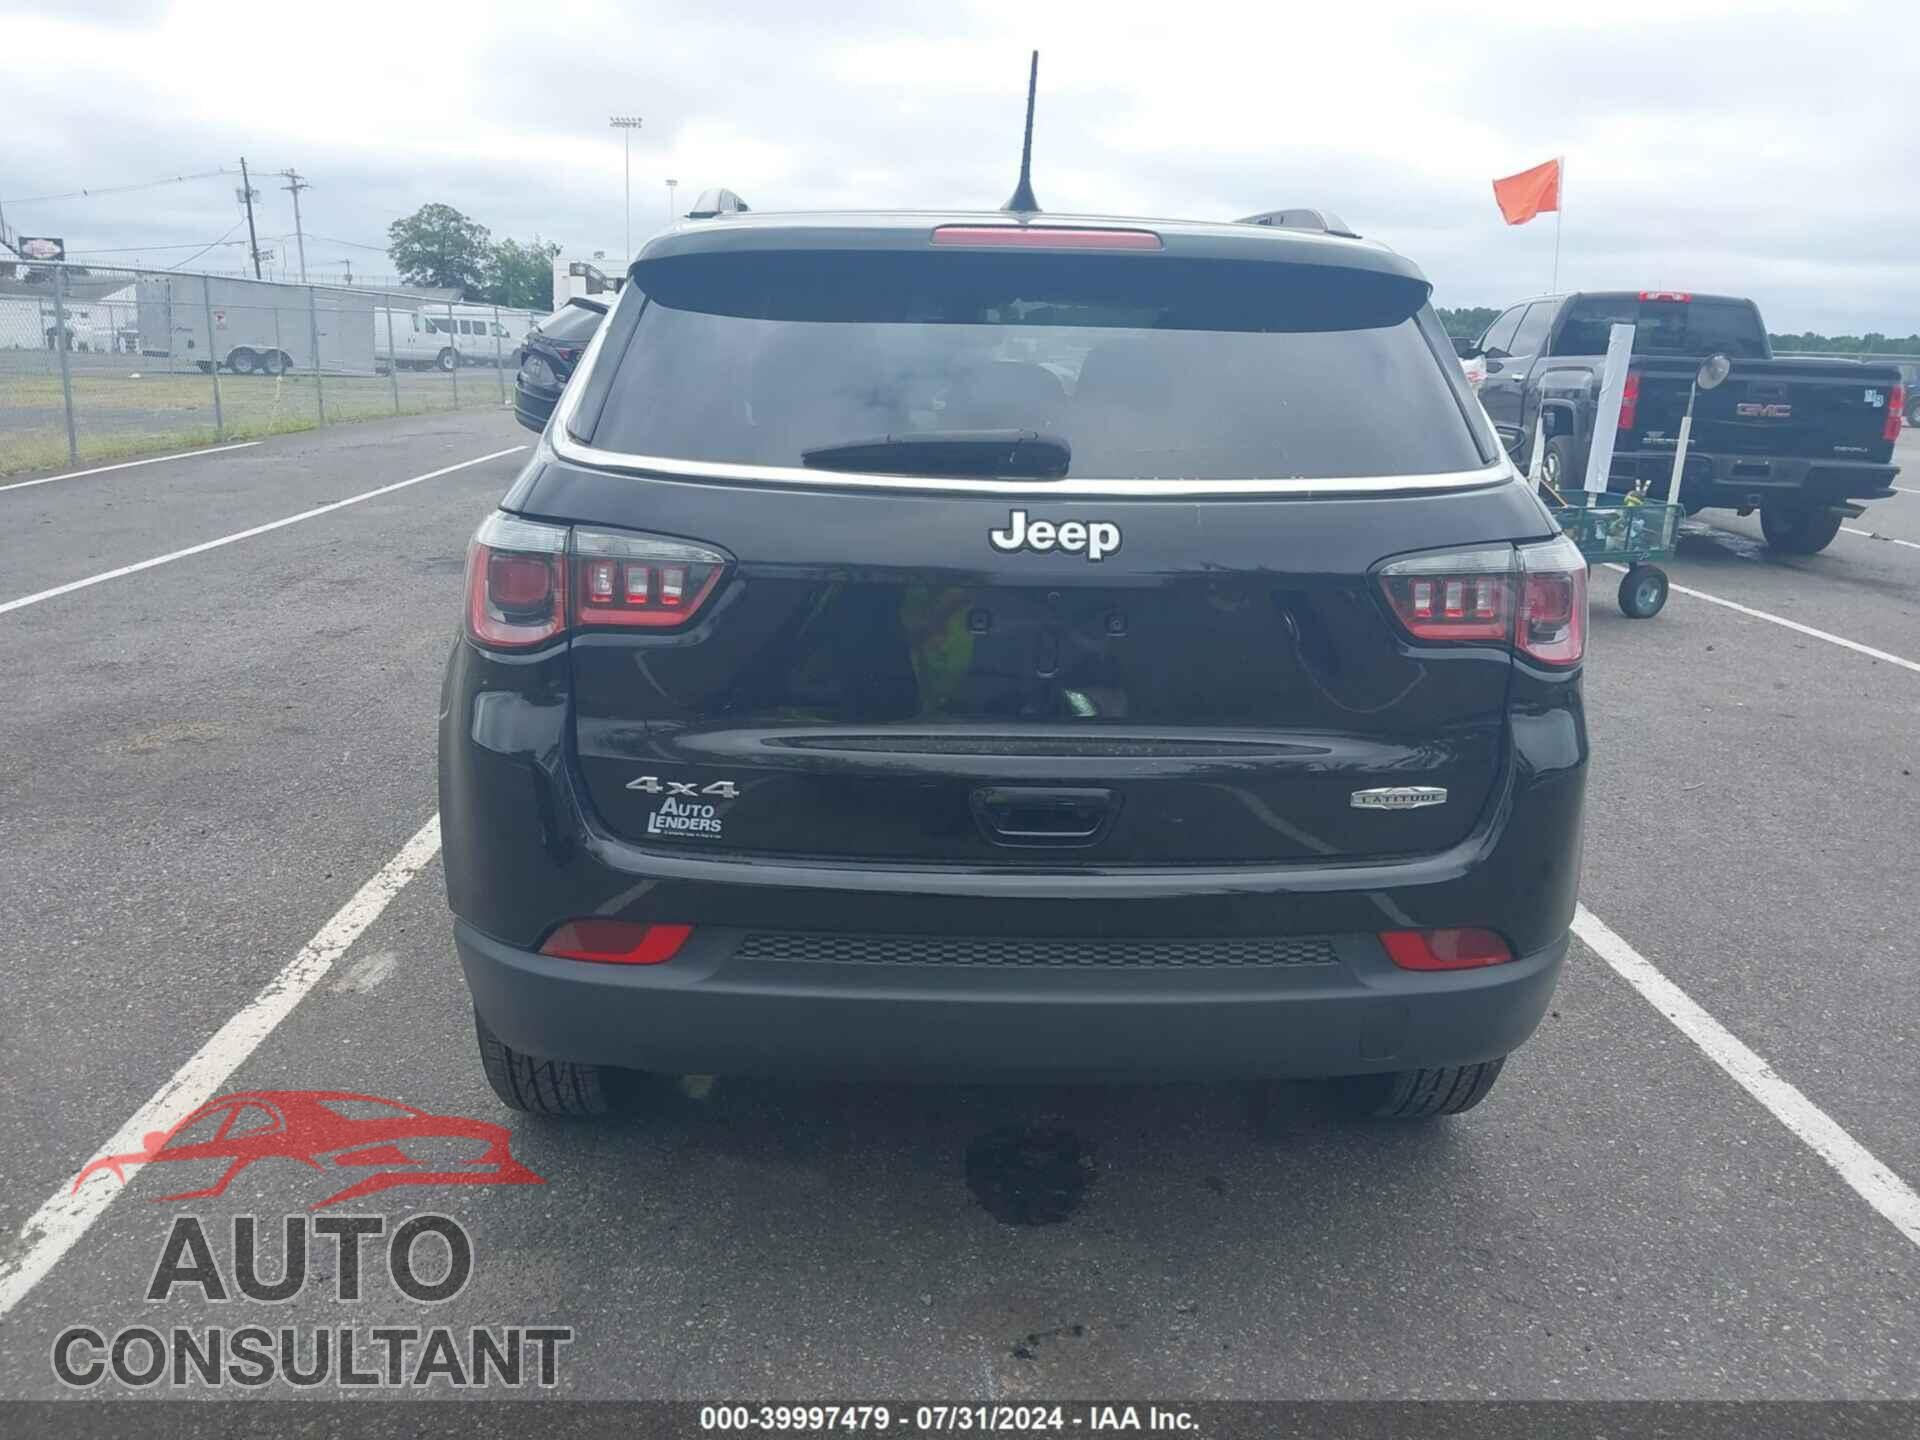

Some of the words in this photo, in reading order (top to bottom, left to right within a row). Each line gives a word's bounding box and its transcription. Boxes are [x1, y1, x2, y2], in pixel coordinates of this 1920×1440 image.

[1736, 403, 1791, 417] GMC
[990, 510, 1121, 560] Jeep
[625, 776, 740, 799] 4x4
[659, 797, 715, 818] AUTO
[1361, 794, 1437, 805] LATITUDE
[647, 812, 723, 834] LENDERS
